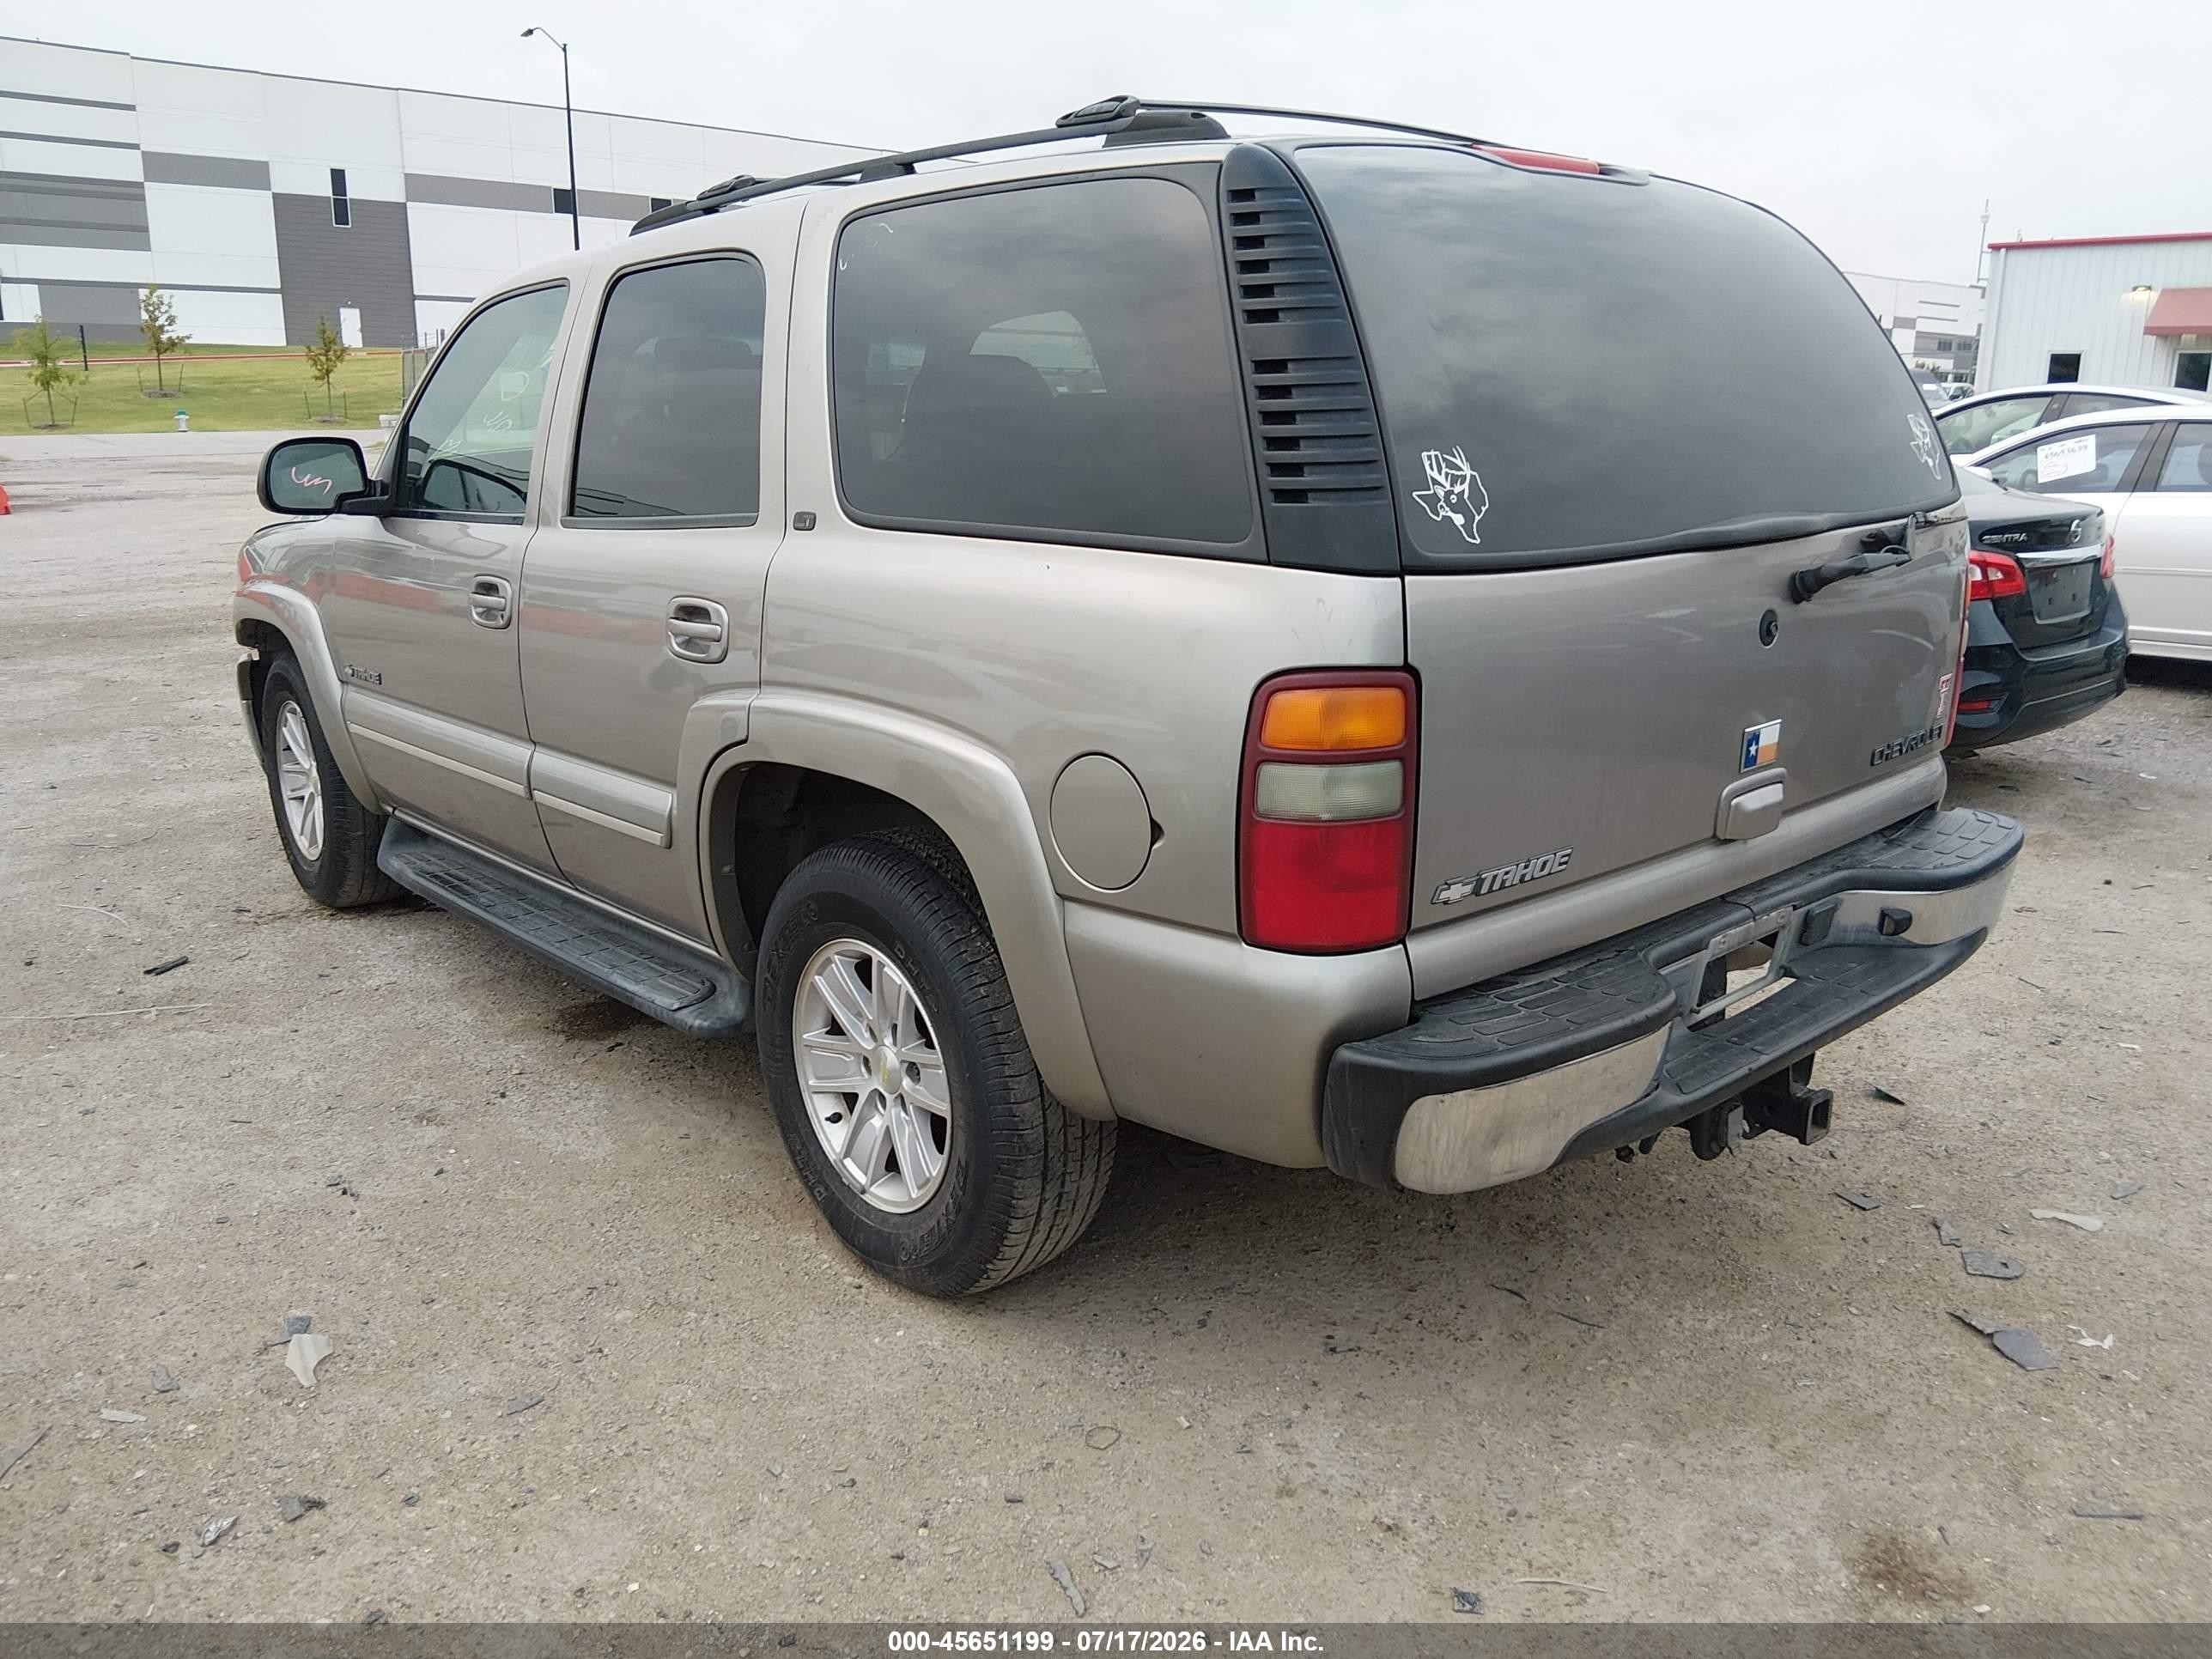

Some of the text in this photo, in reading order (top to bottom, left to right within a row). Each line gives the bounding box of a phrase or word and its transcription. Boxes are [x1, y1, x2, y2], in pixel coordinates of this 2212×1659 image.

[1981, 532, 2028, 544] SENTRA
[1870, 725, 1943, 767] CHEVROLET
[1477, 846, 1574, 896] TAHOE
